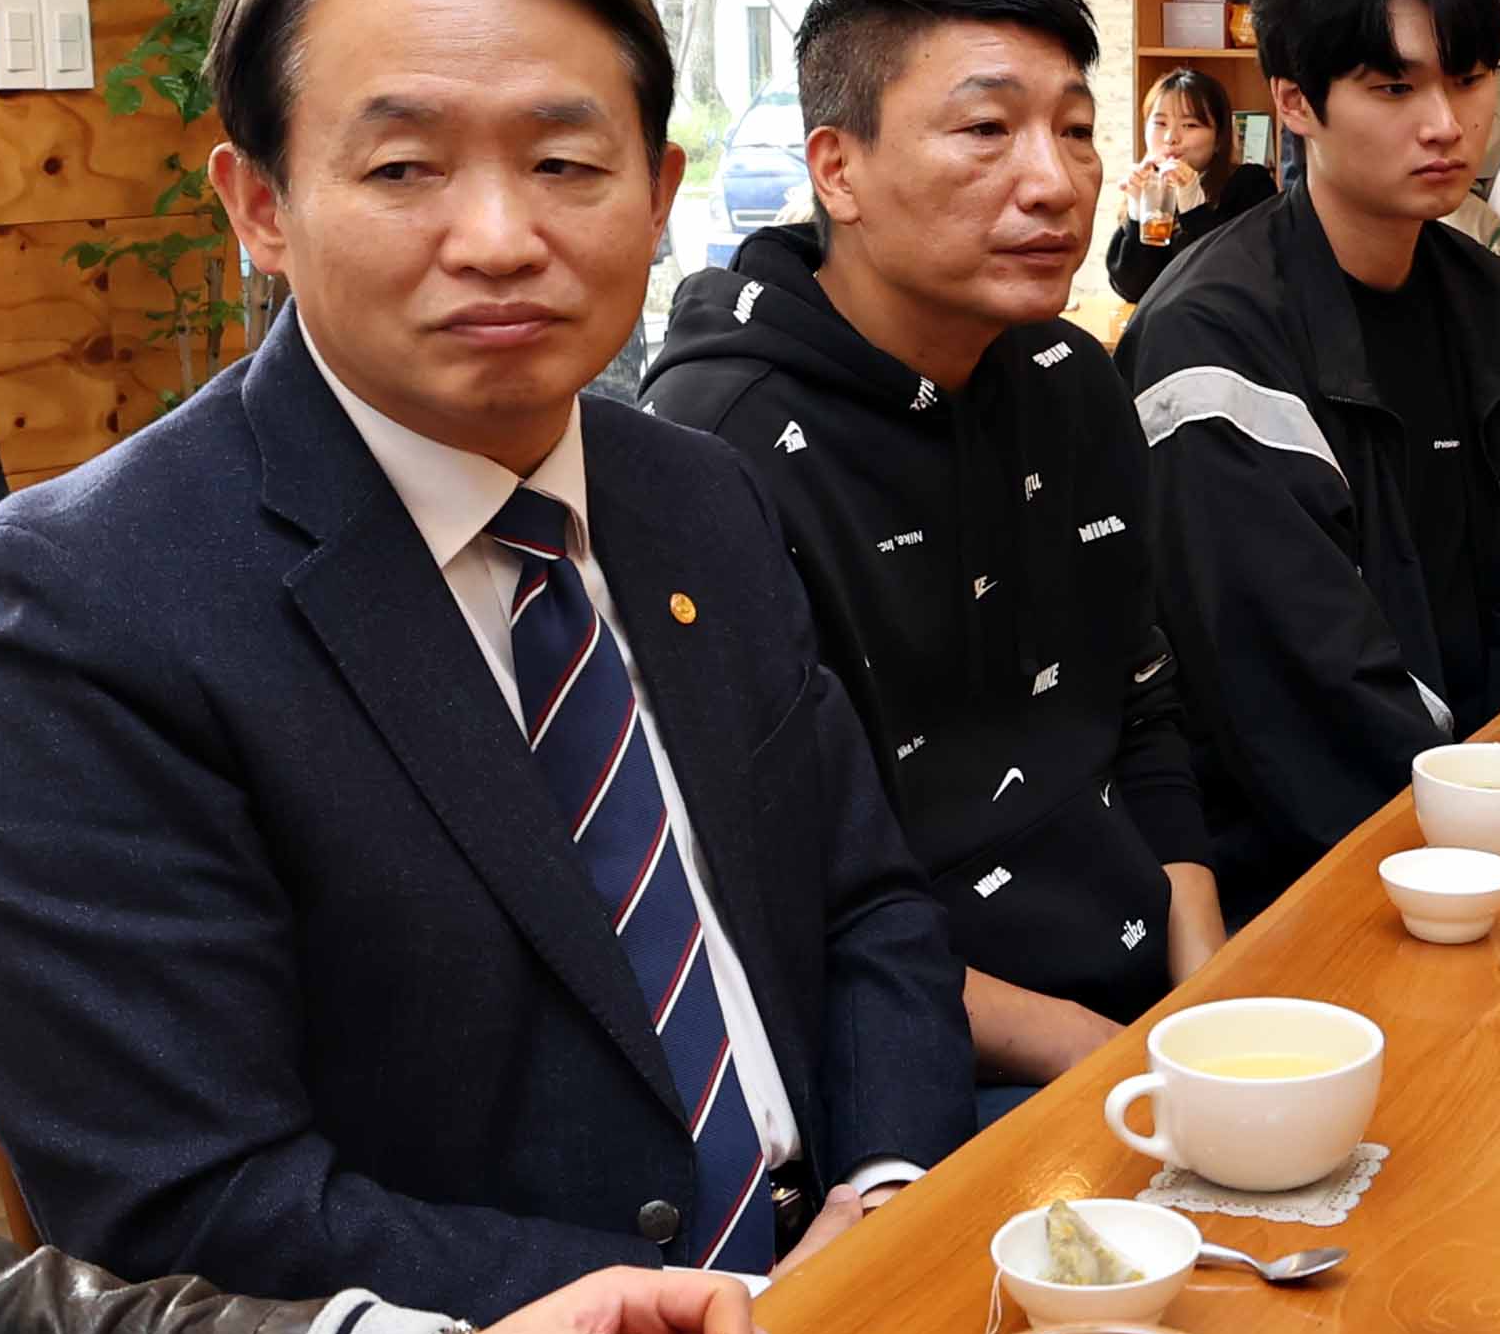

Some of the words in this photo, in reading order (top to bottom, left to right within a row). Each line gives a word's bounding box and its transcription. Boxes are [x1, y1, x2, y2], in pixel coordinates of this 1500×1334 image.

[732, 280, 765, 325] NIKE
[1077, 514, 1127, 543] NIKE
[1031, 661, 1060, 697] NIKE
[972, 866, 1013, 899] NIKE
[1120, 918, 1148, 951] nike
